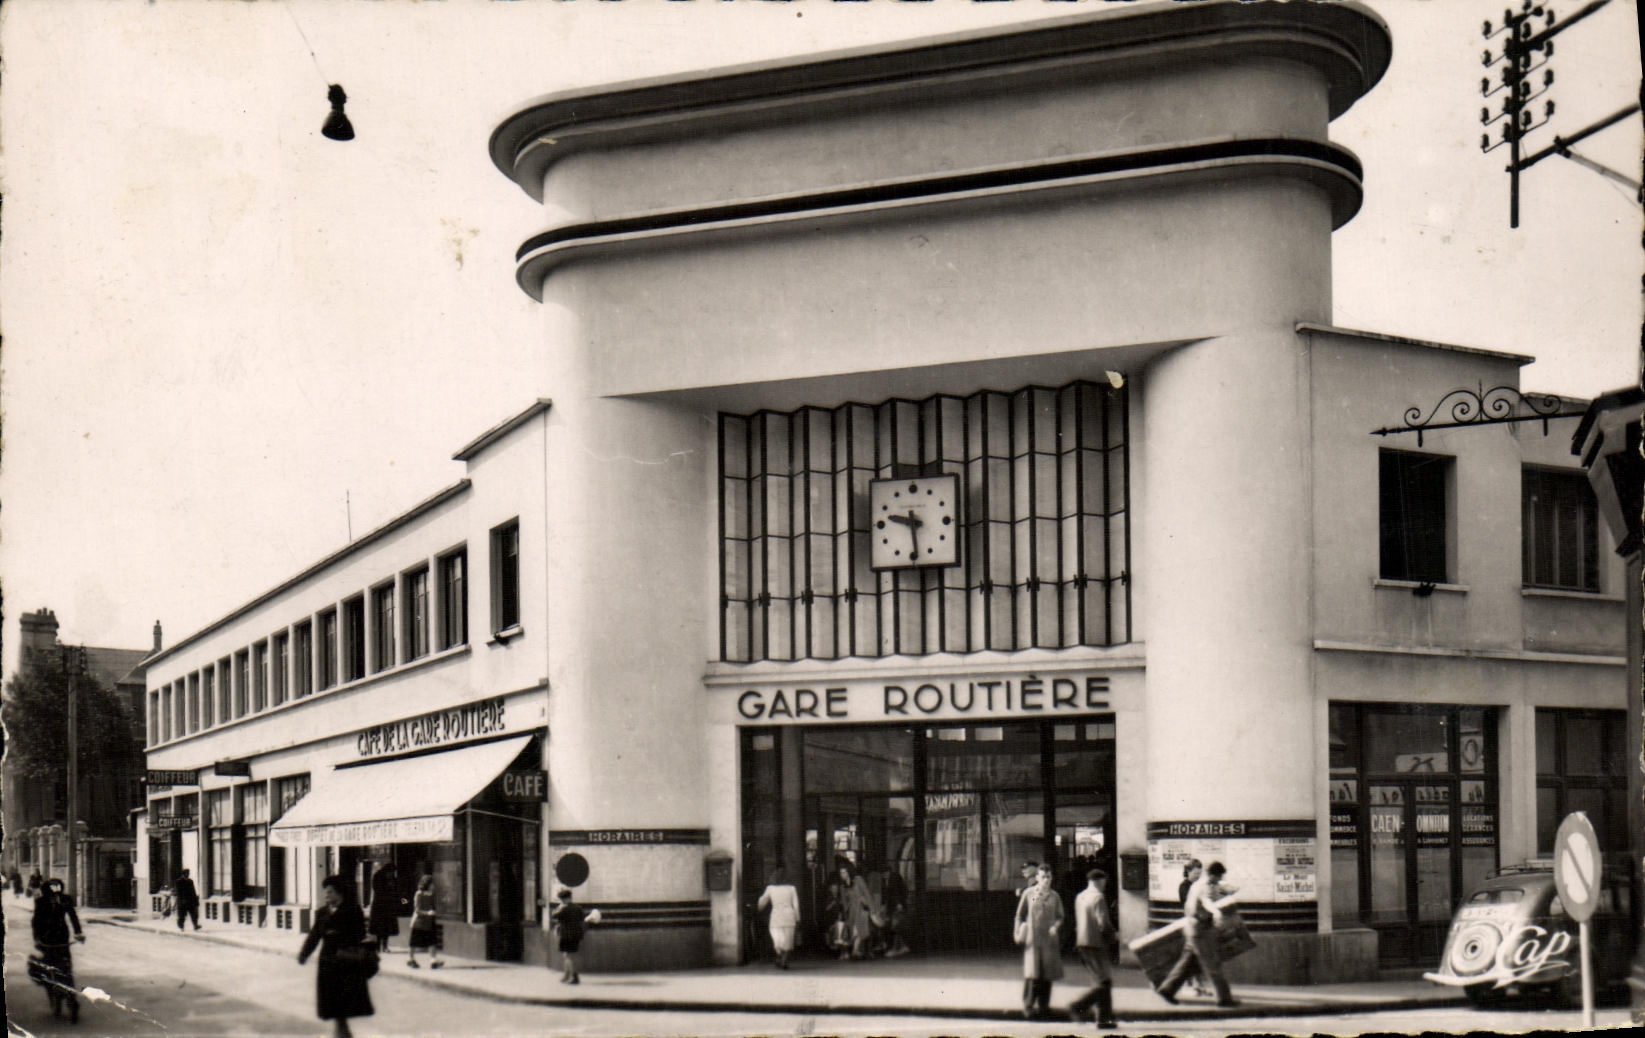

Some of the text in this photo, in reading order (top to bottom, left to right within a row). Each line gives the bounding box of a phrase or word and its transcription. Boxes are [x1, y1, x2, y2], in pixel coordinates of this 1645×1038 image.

[738, 674, 1110, 719] GARE ROUTIÈRE
[383, 724, 395, 753] DE
[396, 721, 410, 750] LA
[411, 714, 441, 746] GARE
[148, 771, 196, 784] COIFFEUR
[503, 772, 543, 796] CAFÉ
[158, 818, 191, 828] COIFFEUR
[1416, 814, 1449, 832] OMNIUM
[1462, 814, 1493, 822] LOCATIONS
[1169, 823, 1246, 835] HORAIRES
[588, 831, 664, 842] HORAIRES
